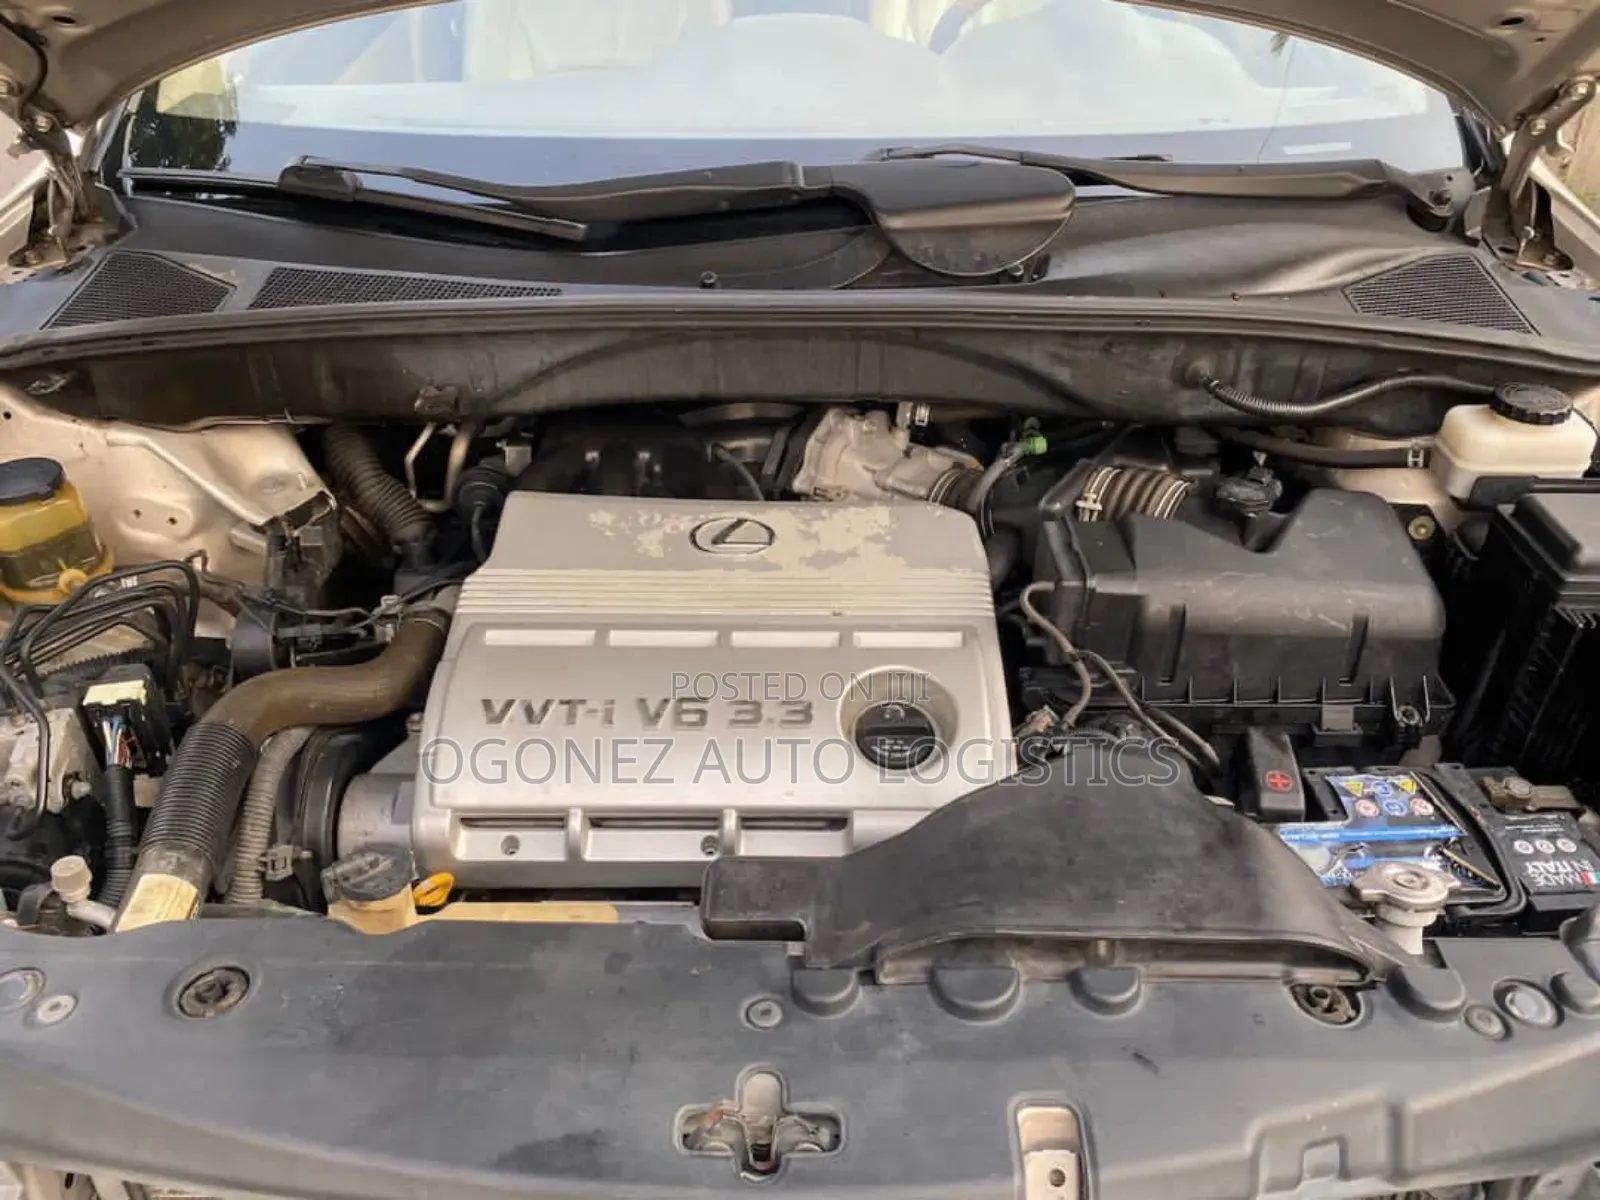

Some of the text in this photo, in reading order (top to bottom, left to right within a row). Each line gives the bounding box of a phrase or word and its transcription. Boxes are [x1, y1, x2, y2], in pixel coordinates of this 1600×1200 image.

[480, 697, 815, 729] VVT-i V6 3.3
